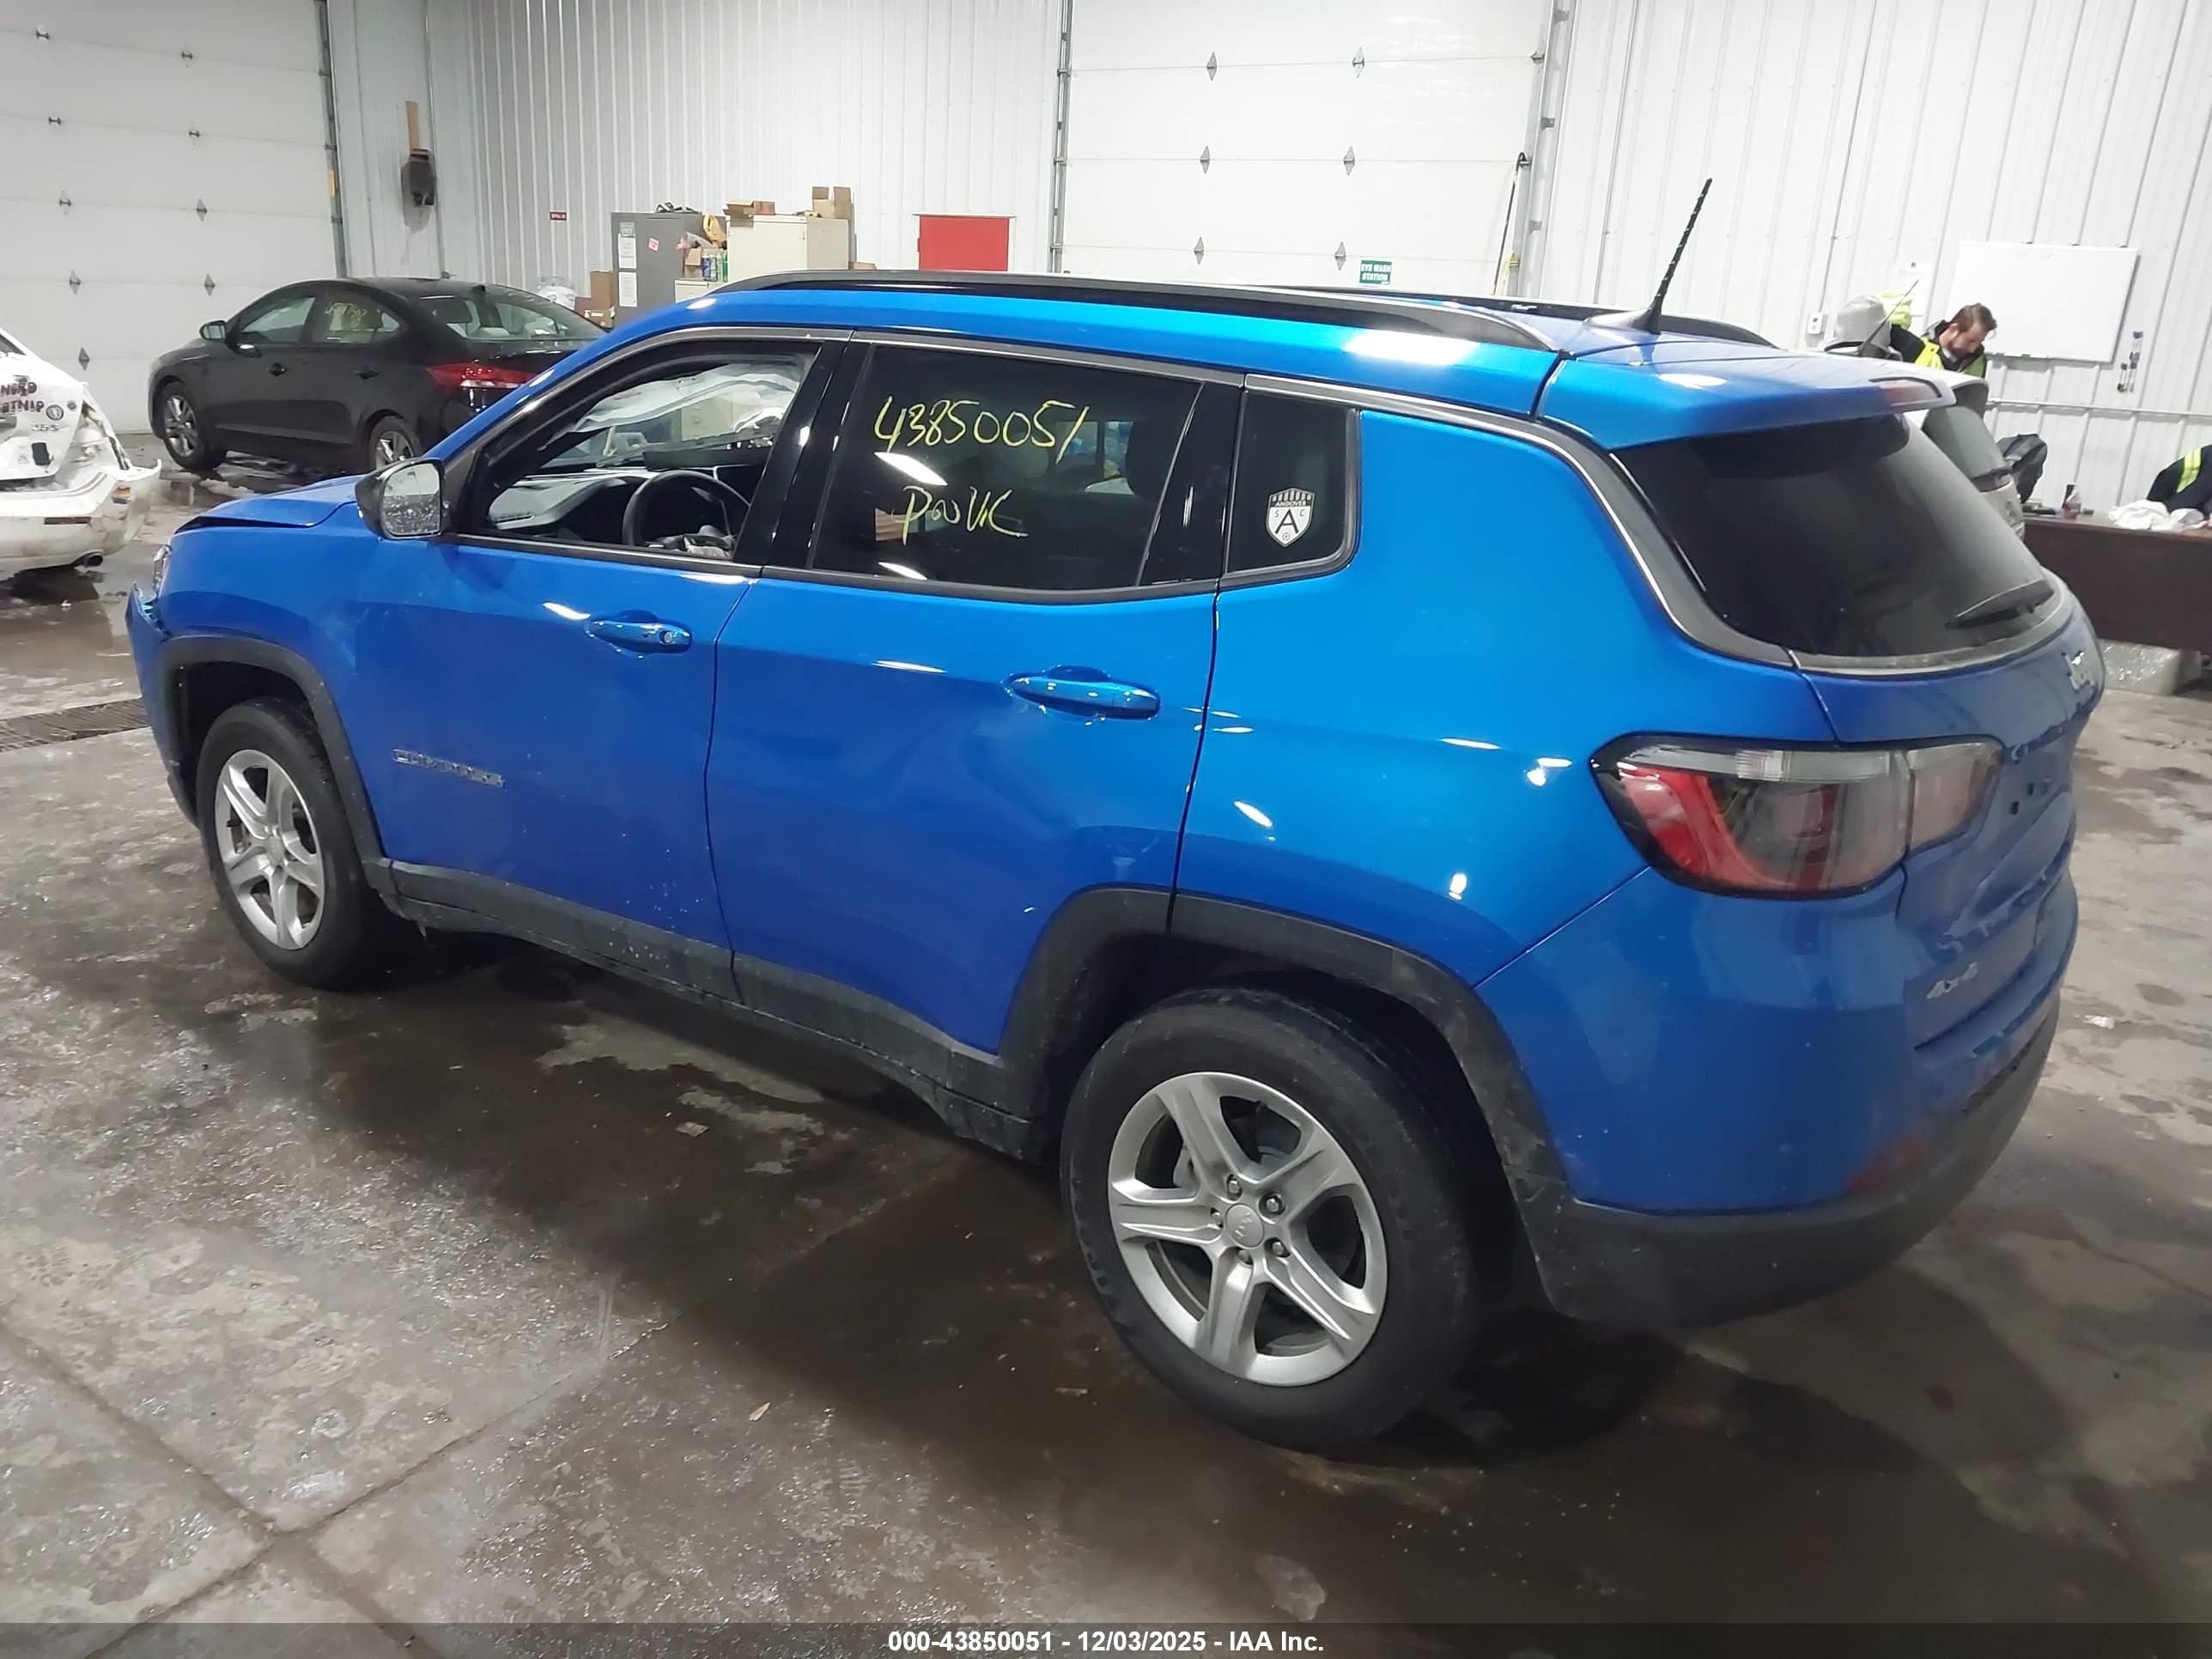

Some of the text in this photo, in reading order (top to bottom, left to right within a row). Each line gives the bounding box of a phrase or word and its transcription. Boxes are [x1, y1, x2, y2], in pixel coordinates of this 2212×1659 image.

[1361, 263, 1391, 273] EYE WASH
[1362, 272, 1389, 282] STATION
[0, 399, 45, 414] ATNIP
[874, 396, 1090, 465] 43850051
[1274, 508, 1299, 534] A
